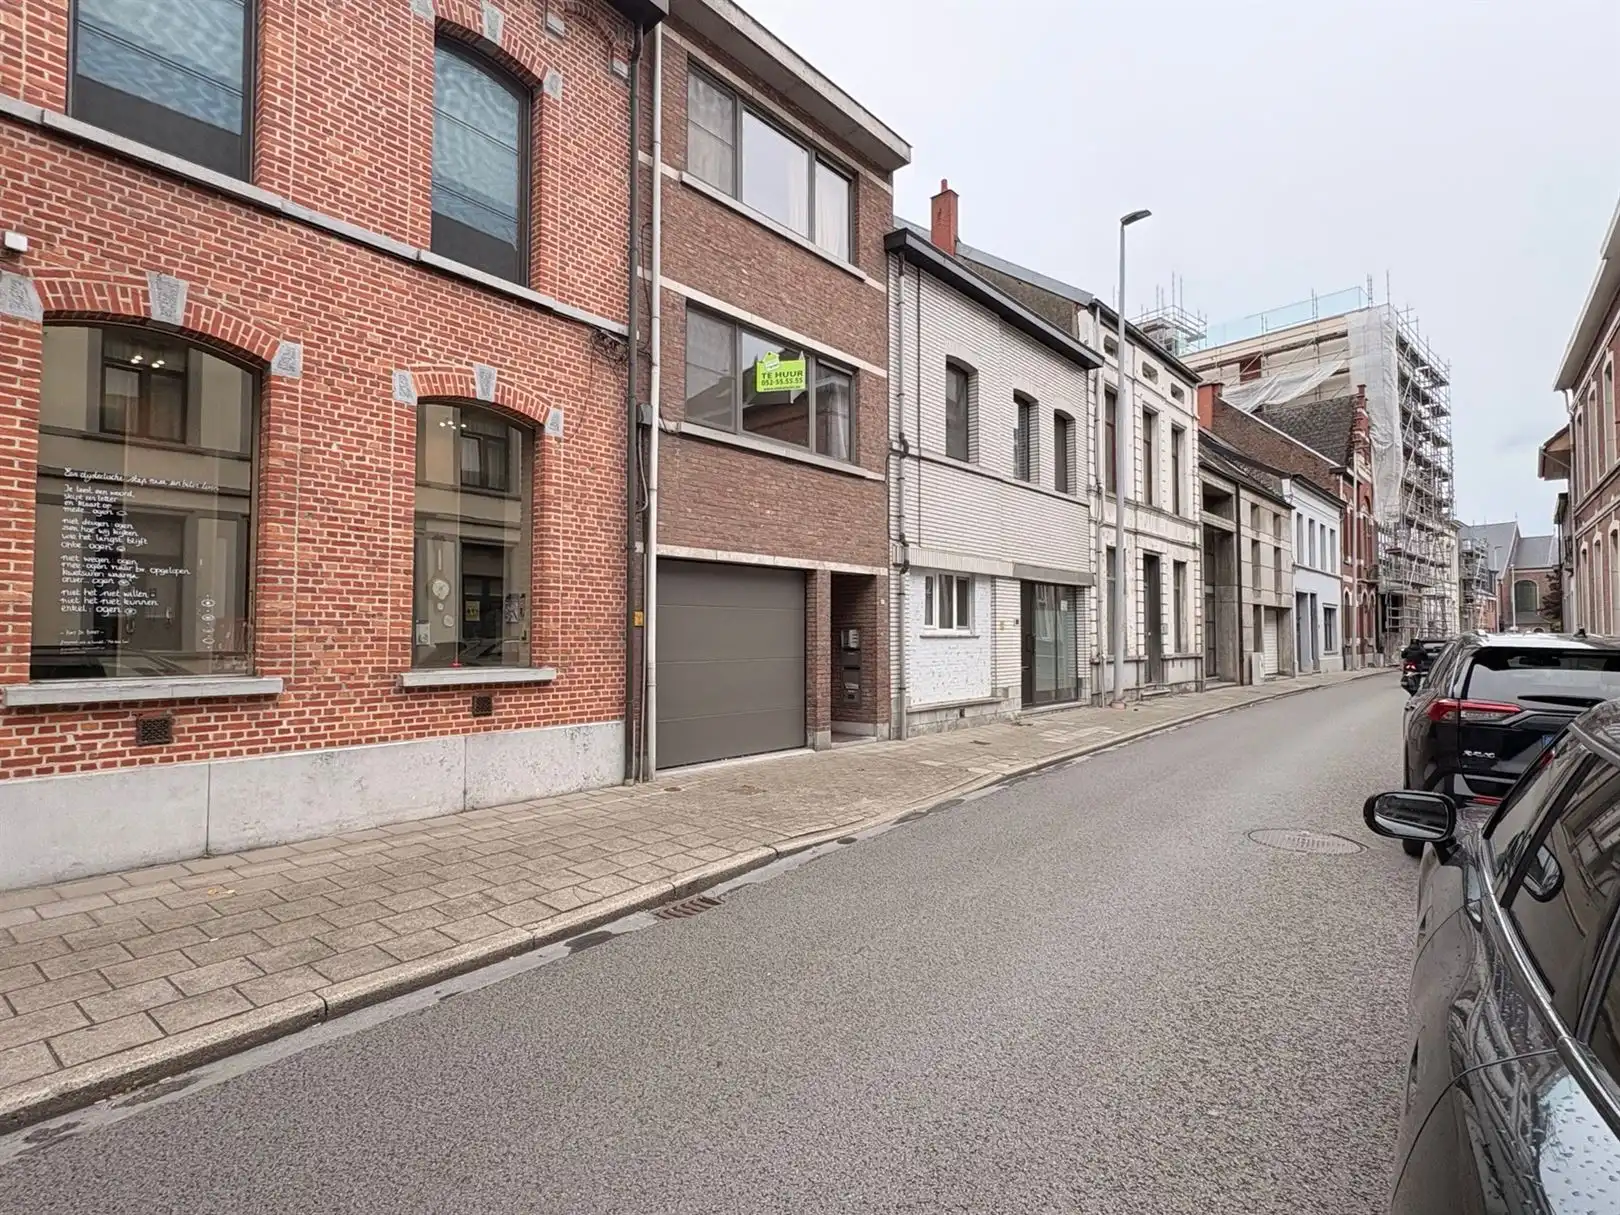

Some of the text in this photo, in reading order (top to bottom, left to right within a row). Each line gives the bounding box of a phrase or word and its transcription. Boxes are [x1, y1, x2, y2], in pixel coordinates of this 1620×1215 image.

[64, 484, 73, 492] Je
[92, 509, 114, 517] ogen
[115, 522, 134, 530] ogen
[78, 532, 92, 541] het
[88, 543, 114, 552] ogen
[60, 554, 80, 562] niet
[149, 566, 191, 577] opgelopen
[91, 578, 114, 587] ogen
[61, 588, 80, 596] niet
[84, 588, 97, 597] het
[100, 589, 121, 598] niet
[123, 587, 149, 598] willen
[60, 596, 158, 606] niet het niet kunnen
[61, 605, 87, 613] enkel
[95, 605, 121, 617] ogen
